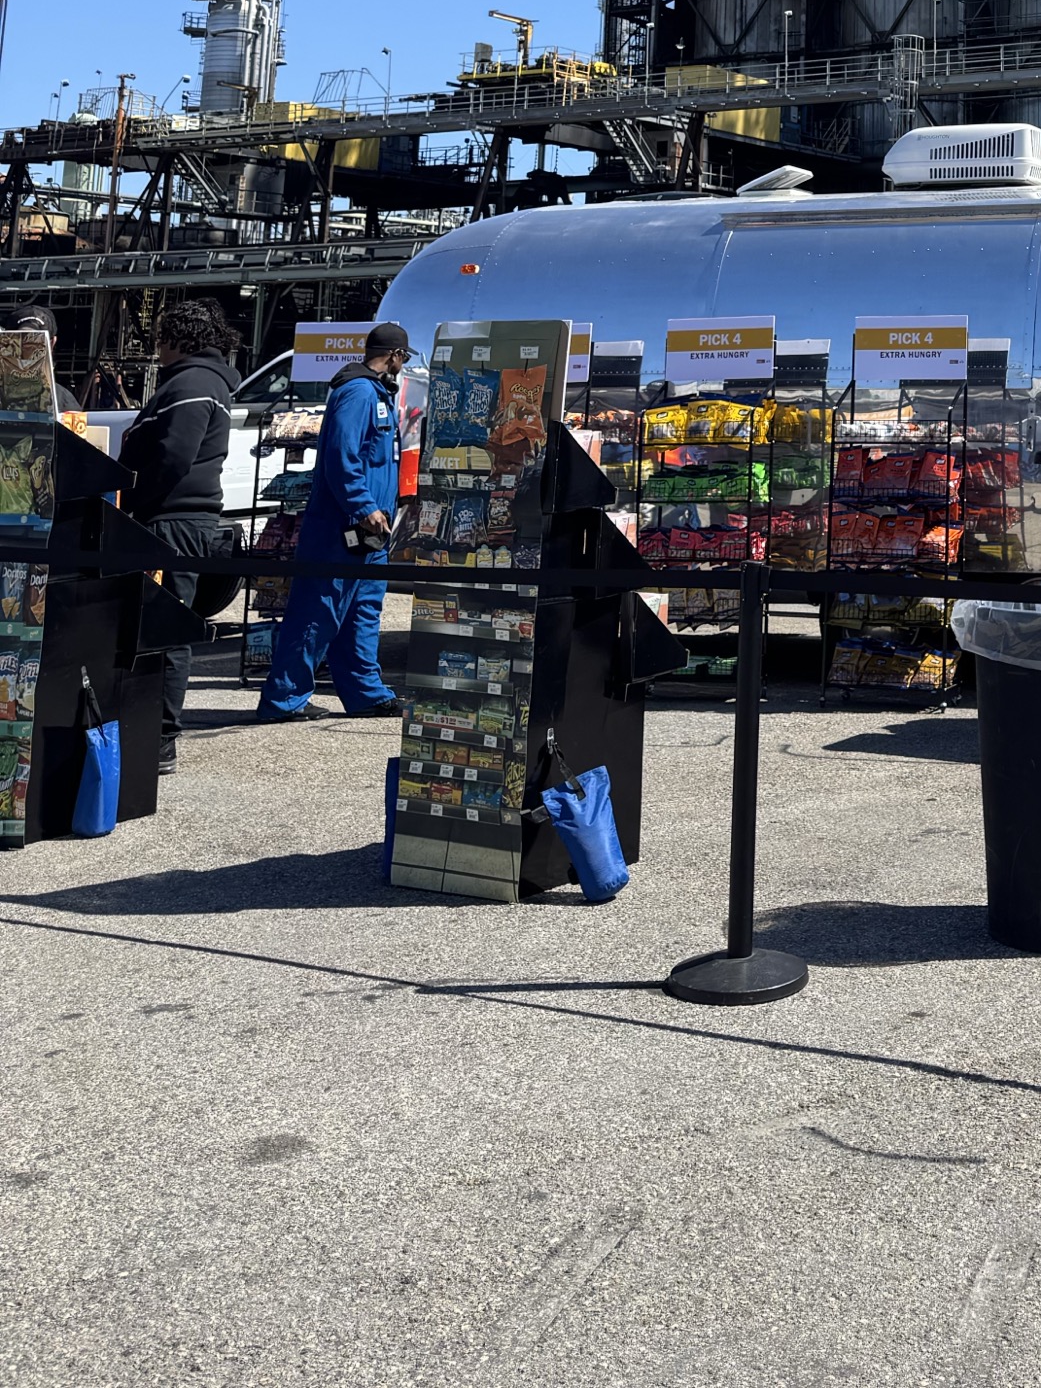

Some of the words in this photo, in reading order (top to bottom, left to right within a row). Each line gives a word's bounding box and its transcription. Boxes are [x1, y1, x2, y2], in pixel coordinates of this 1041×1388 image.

[325, 338, 354, 349] PICK
[357, 338, 366, 349] 4
[699, 333, 729, 346] PICK
[733, 333, 742, 345] 4
[889, 332, 921, 345] PICK
[924, 332, 934, 344] 4
[690, 352, 715, 360] EXTRA
[717, 351, 749, 359] HUNGRY
